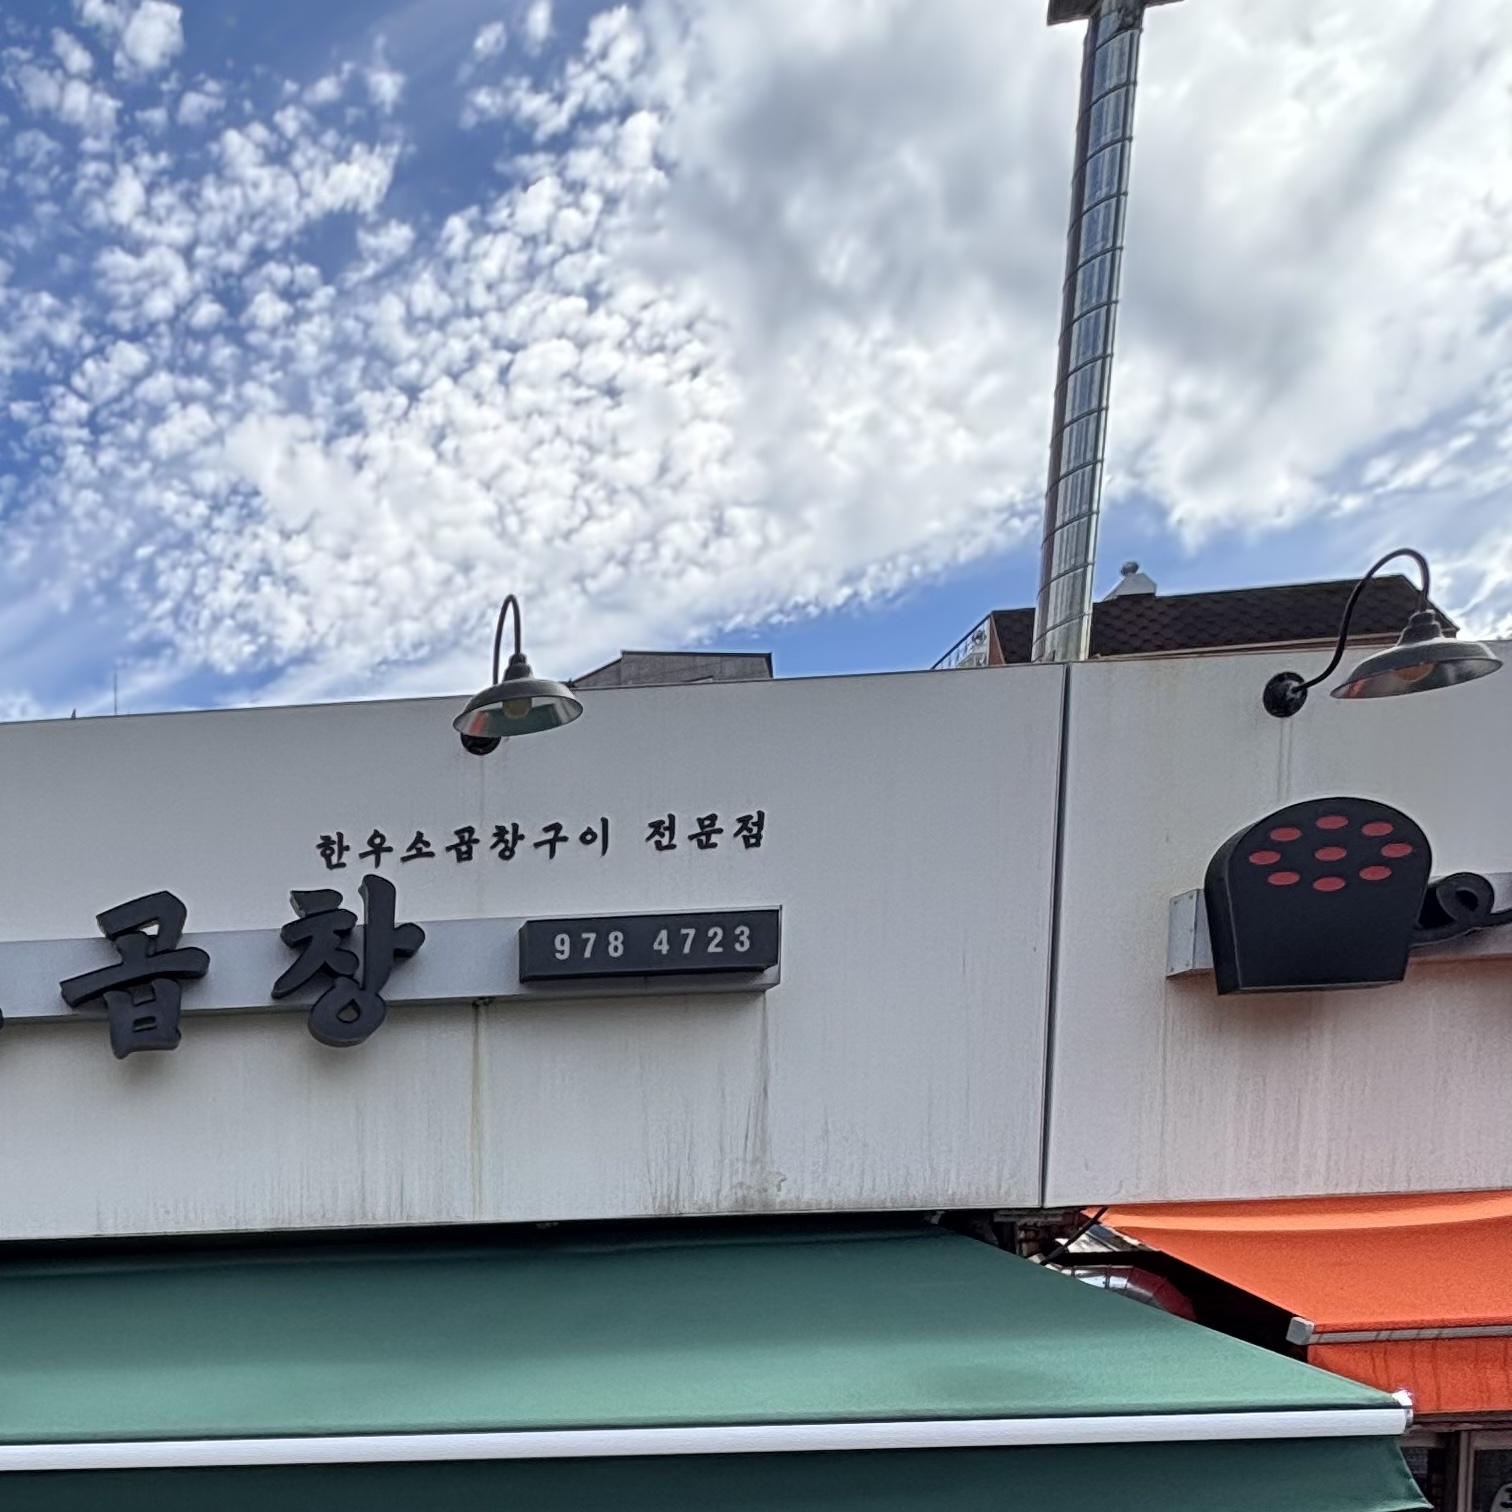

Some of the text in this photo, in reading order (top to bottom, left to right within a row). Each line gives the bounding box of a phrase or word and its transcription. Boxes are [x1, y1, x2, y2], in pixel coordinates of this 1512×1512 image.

[316, 810, 767, 869] 한우소곱창구이 전문점
[554, 924, 753, 961] 978 4723
